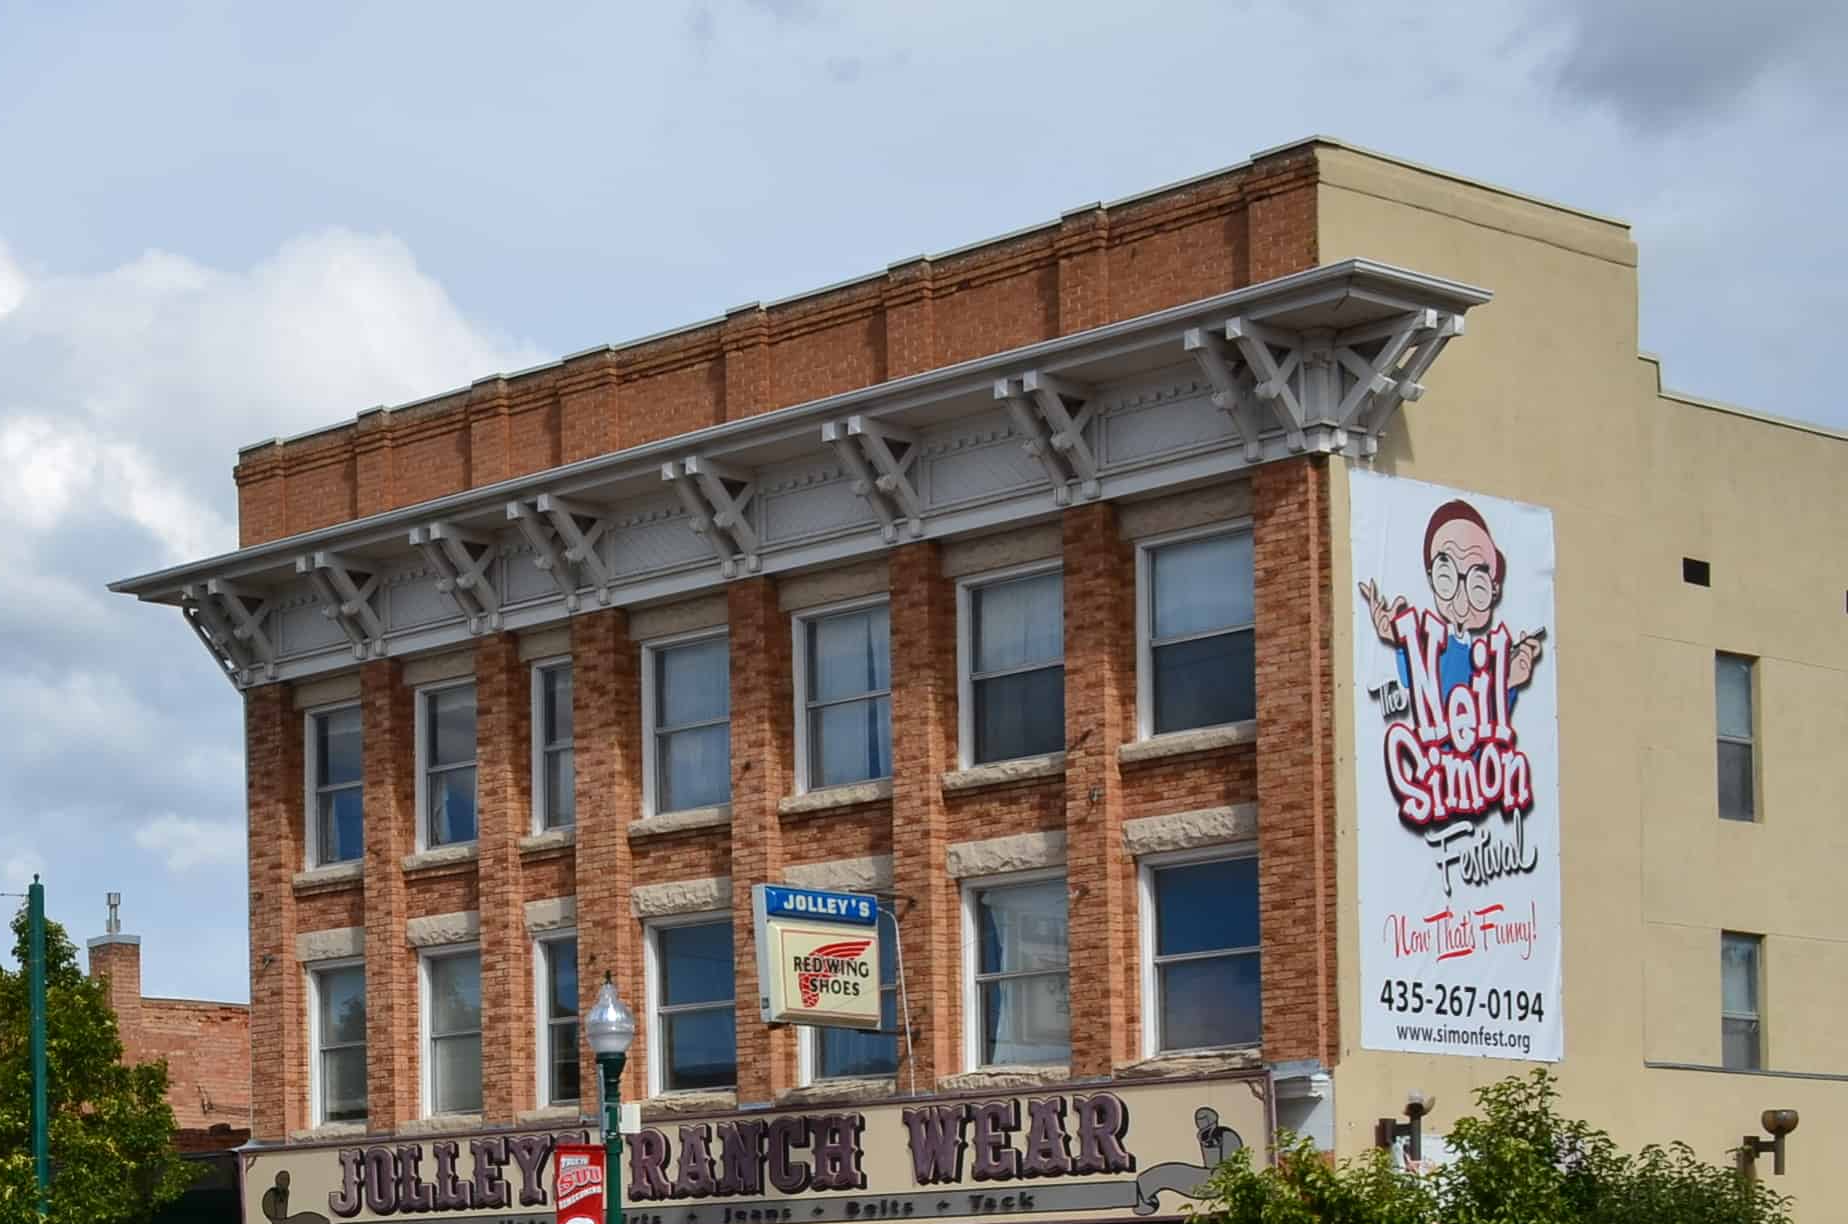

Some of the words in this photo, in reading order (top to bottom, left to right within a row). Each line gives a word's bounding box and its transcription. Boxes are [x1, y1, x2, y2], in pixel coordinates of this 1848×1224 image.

[1367, 679, 1409, 720] The
[1390, 606, 1516, 754] Neil
[1384, 722, 1534, 826] Simon
[1425, 807, 1539, 898] Festival
[783, 893, 871, 918] JOLLEY'S
[1383, 913, 1431, 958] Now
[1423, 905, 1476, 962] That's
[1474, 901, 1537, 961] Funny!
[793, 956, 824, 973] RED
[825, 958, 870, 978] WING
[809, 977, 860, 997] SHOES
[1380, 978, 1545, 1023] 435-267-0194
[1396, 1022, 1531, 1054] www.simonfest.org
[328, 1130, 589, 1218] JOLLEY
[626, 1112, 867, 1202] RANCH
[902, 1091, 1137, 1186] WEAR
[724, 1206, 793, 1224] Jeans
[845, 1199, 915, 1219] Belts
[968, 1190, 1035, 1211] Tack
